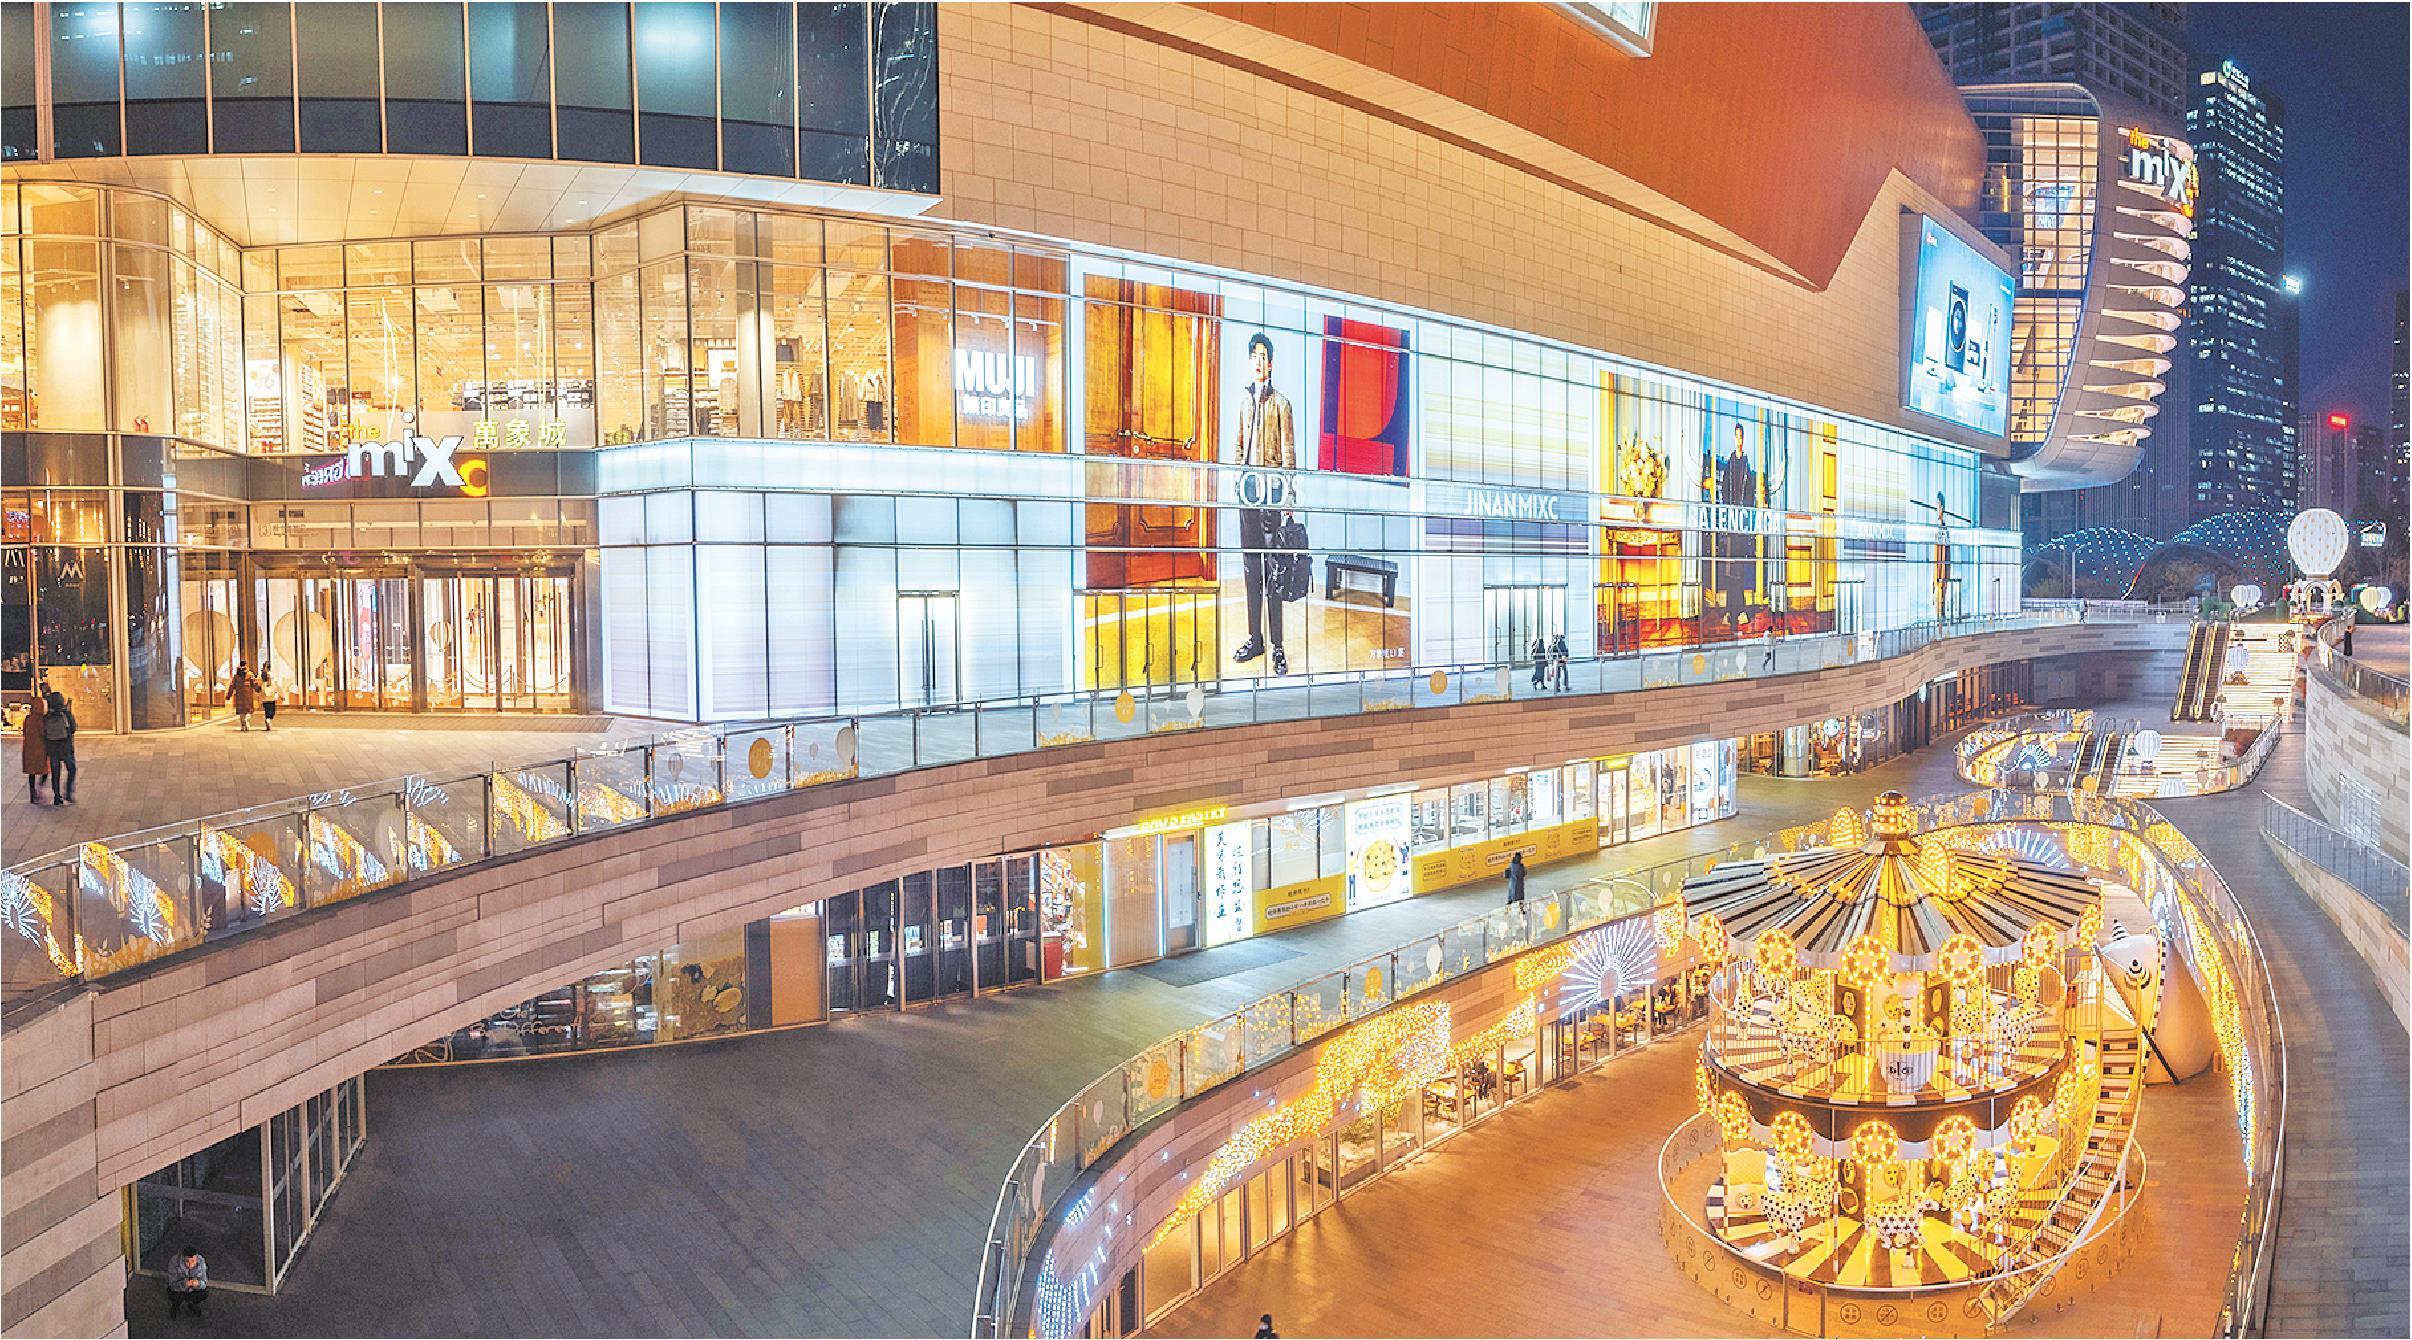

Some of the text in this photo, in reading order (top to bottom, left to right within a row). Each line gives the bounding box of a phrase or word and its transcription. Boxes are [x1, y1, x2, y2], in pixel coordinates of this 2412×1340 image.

[2129, 127, 2150, 150] the
[954, 348, 1036, 397] MUJI
[346, 419, 381, 440] the
[472, 418, 568, 449] 萬象城
[1691, 505, 1786, 535] ALENCIAGA
